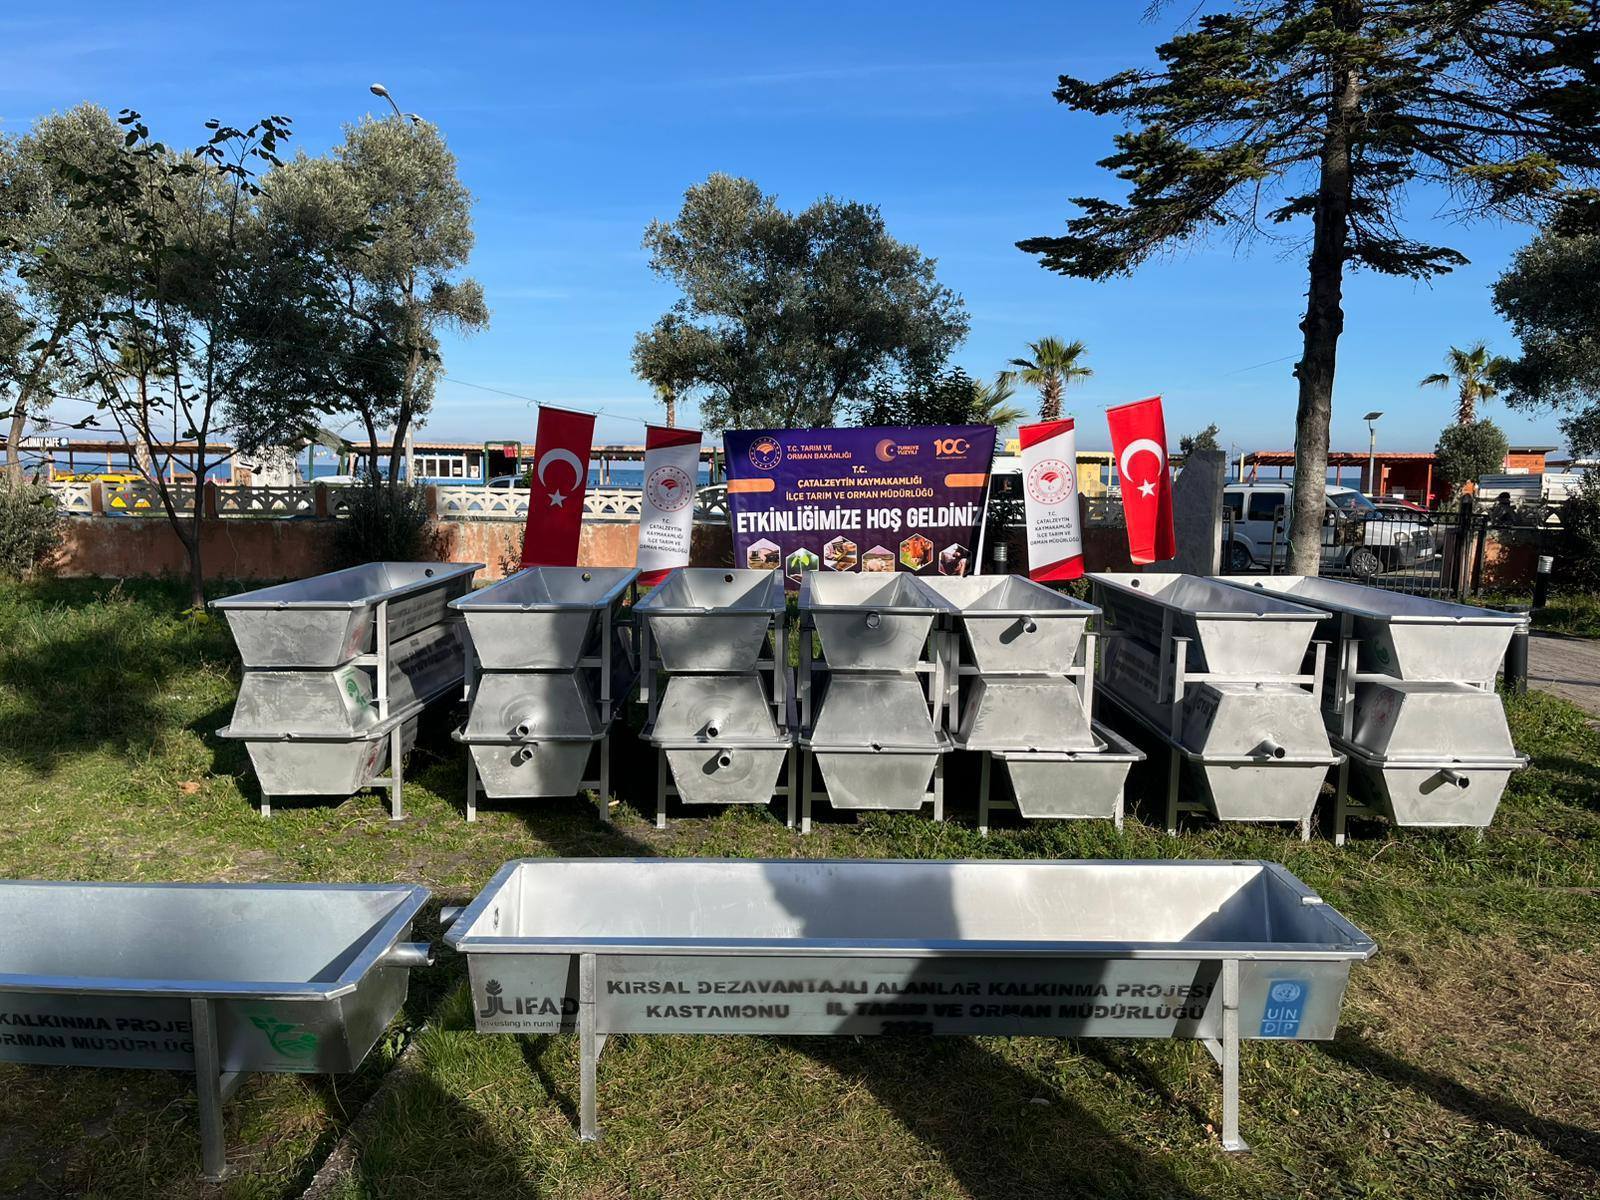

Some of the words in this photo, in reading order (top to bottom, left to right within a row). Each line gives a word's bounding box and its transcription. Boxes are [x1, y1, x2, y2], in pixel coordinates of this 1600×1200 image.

[45, 437, 59, 447] CAFE
[852, 465, 868, 473] T.C.
[797, 477, 856, 488] ÇATALZEYTİN
[857, 475, 922, 486] KAYMAKAMLIĞI
[786, 491, 804, 502] İLÇE
[806, 491, 832, 500] TARIM
[833, 491, 845, 499] VE
[847, 490, 878, 499] ORMAN
[880, 487, 934, 498] MÜDÜRLÜĞÜ
[736, 505, 861, 533] ETKİNLİĞİMİZE
[867, 507, 902, 532] HOŞ
[906, 502, 982, 528] GELDİNİZ
[607, 979, 690, 994] KIRSAL
[698, 979, 868, 995] DEZAVANTAJLI
[875, 981, 981, 996] ALANLAR
[988, 982, 1108, 997] KALKINMA
[1116, 981, 1213, 998] PROJESİ
[515, 997, 580, 1015] IFAD
[646, 1004, 789, 1019] KASTAMONU
[933, 1003, 964, 1018] VE
[969, 1003, 1051, 1018] ORMAN
[1059, 1002, 1205, 1020] MÜDÜRLÜĞÜ
[0, 1013, 112, 1031] KALKINMA
[115, 1018, 193, 1032] PROJE
[523, 1019, 531, 1027] in
[534, 1019, 553, 1027] rural
